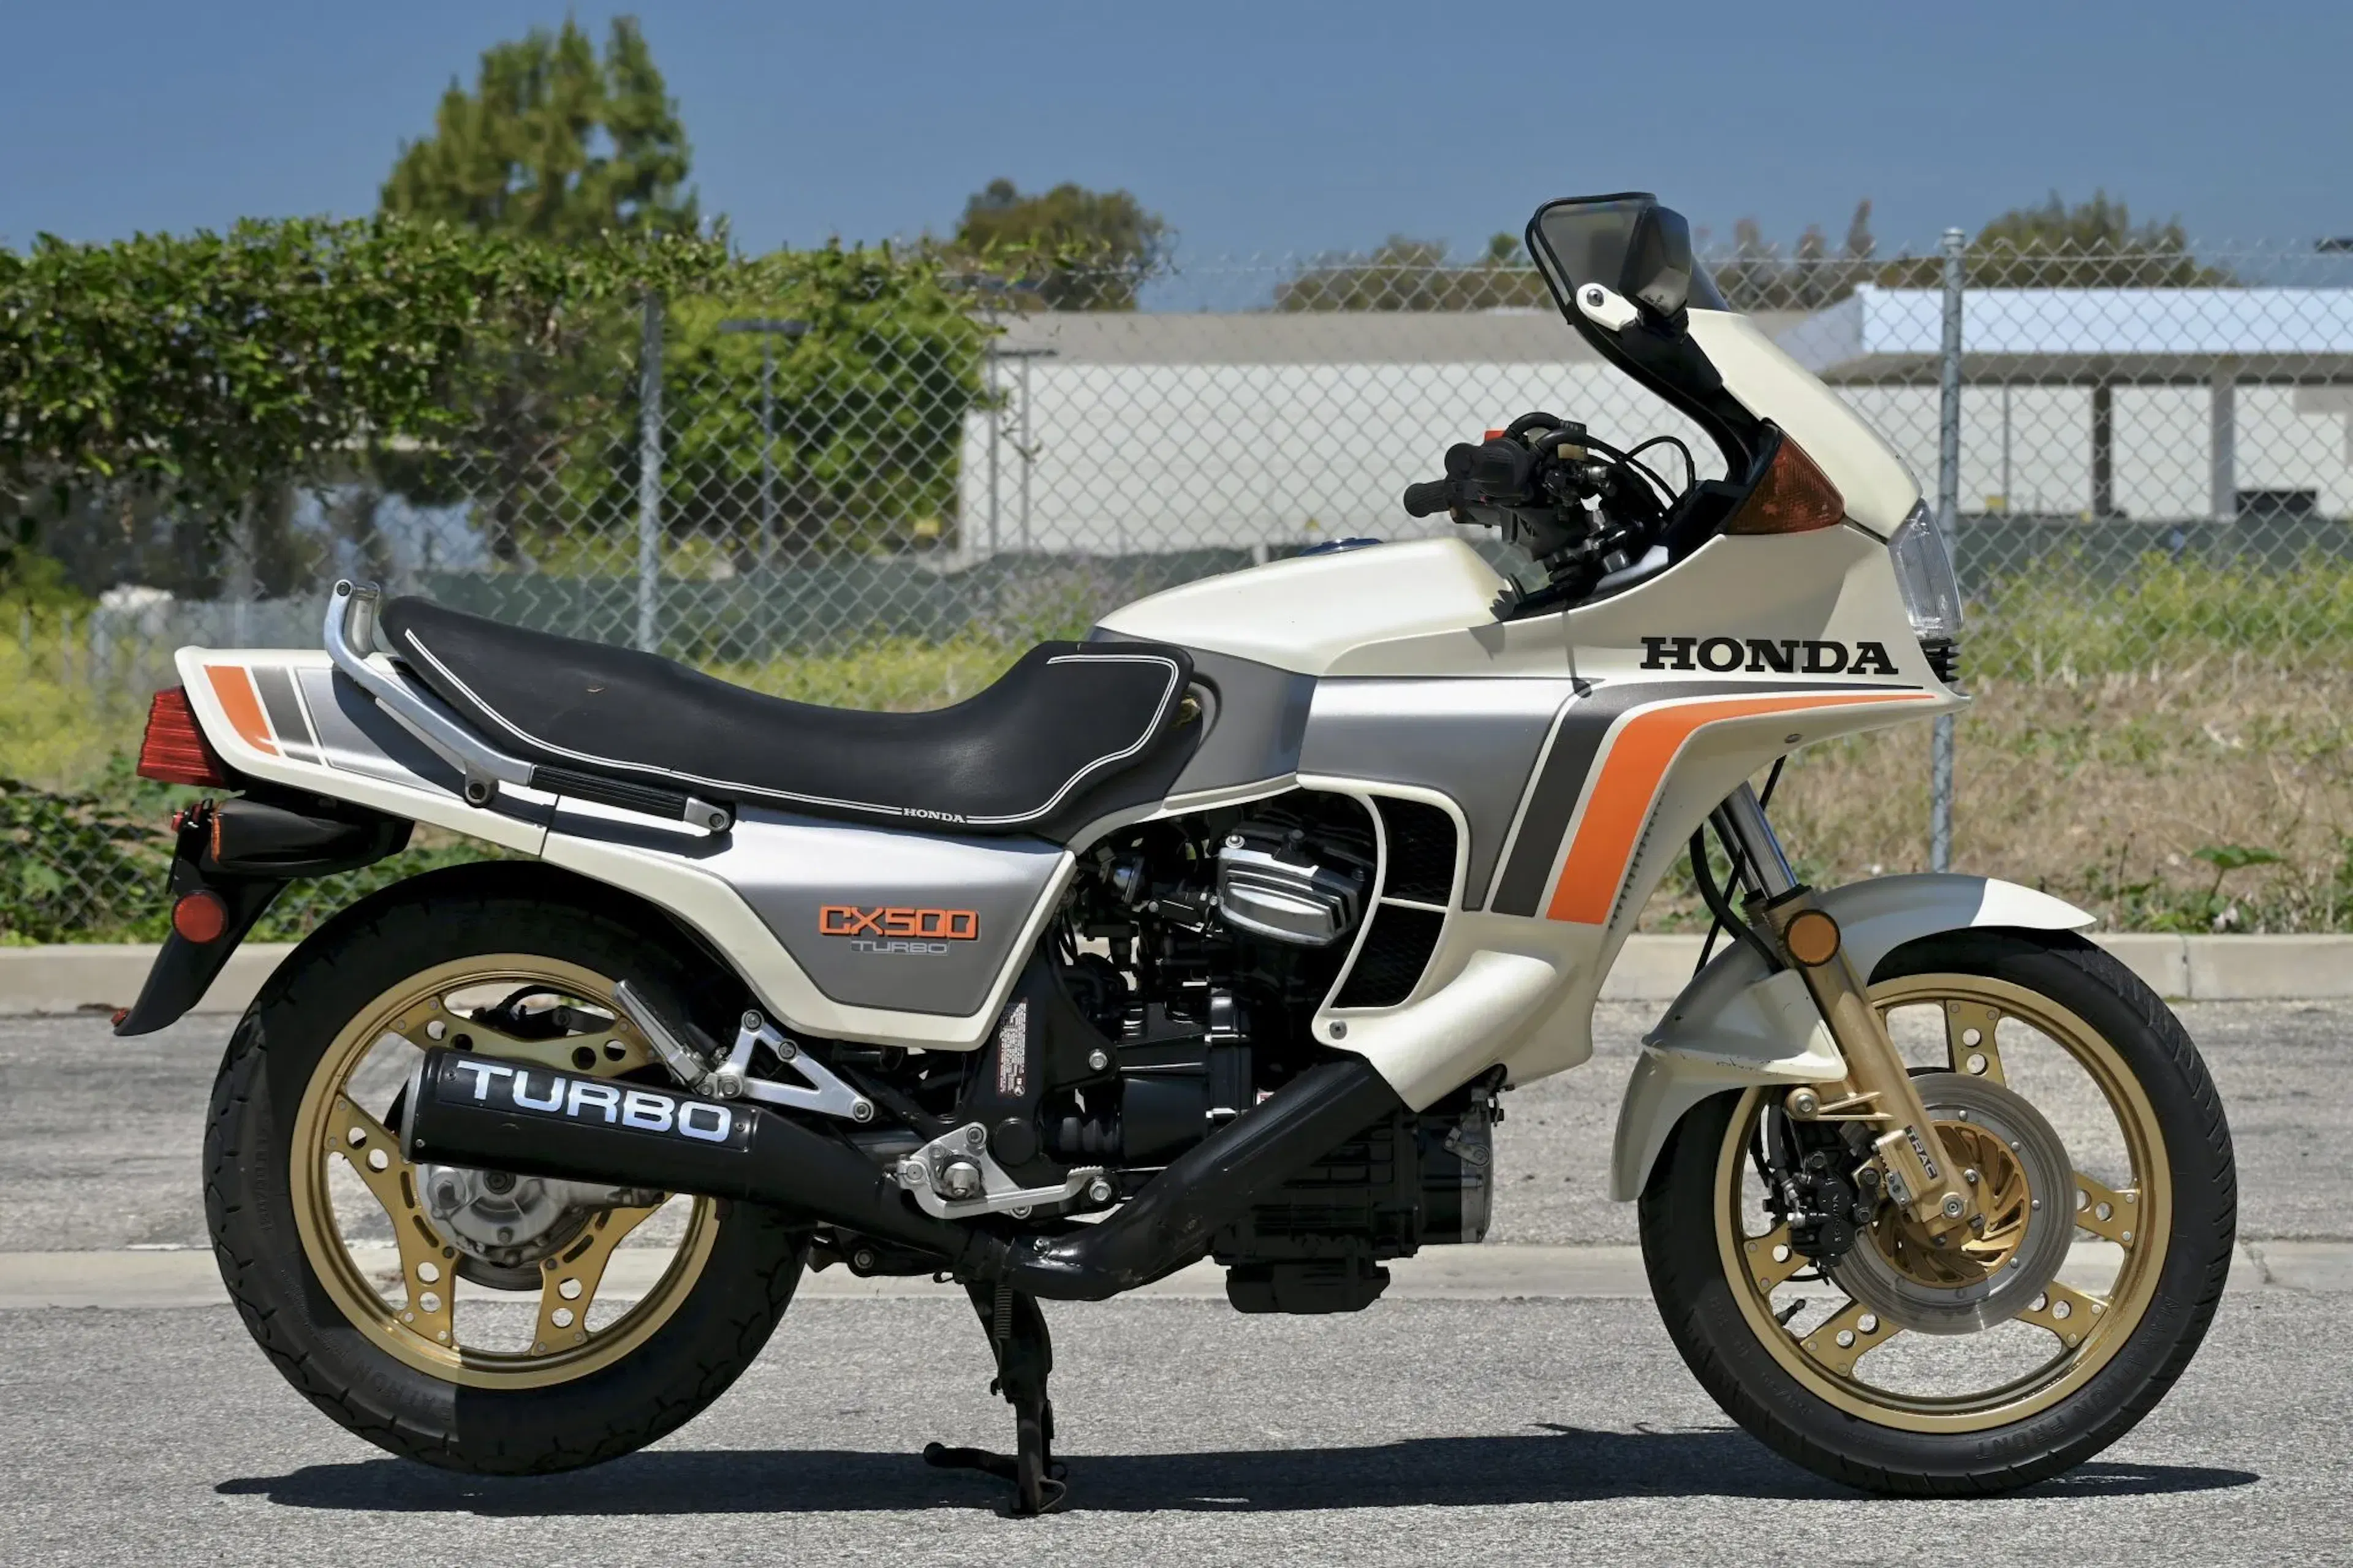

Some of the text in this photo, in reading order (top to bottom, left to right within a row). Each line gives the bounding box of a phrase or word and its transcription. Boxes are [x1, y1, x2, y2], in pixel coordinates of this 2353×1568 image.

[1640, 637, 1898, 674] HONDA
[903, 808, 966, 824] HONDA
[819, 904, 979, 941] CX500
[851, 940, 949, 955] TURBO
[457, 1060, 732, 1143] TURBO
[1908, 1127, 1938, 1178] TRAC
